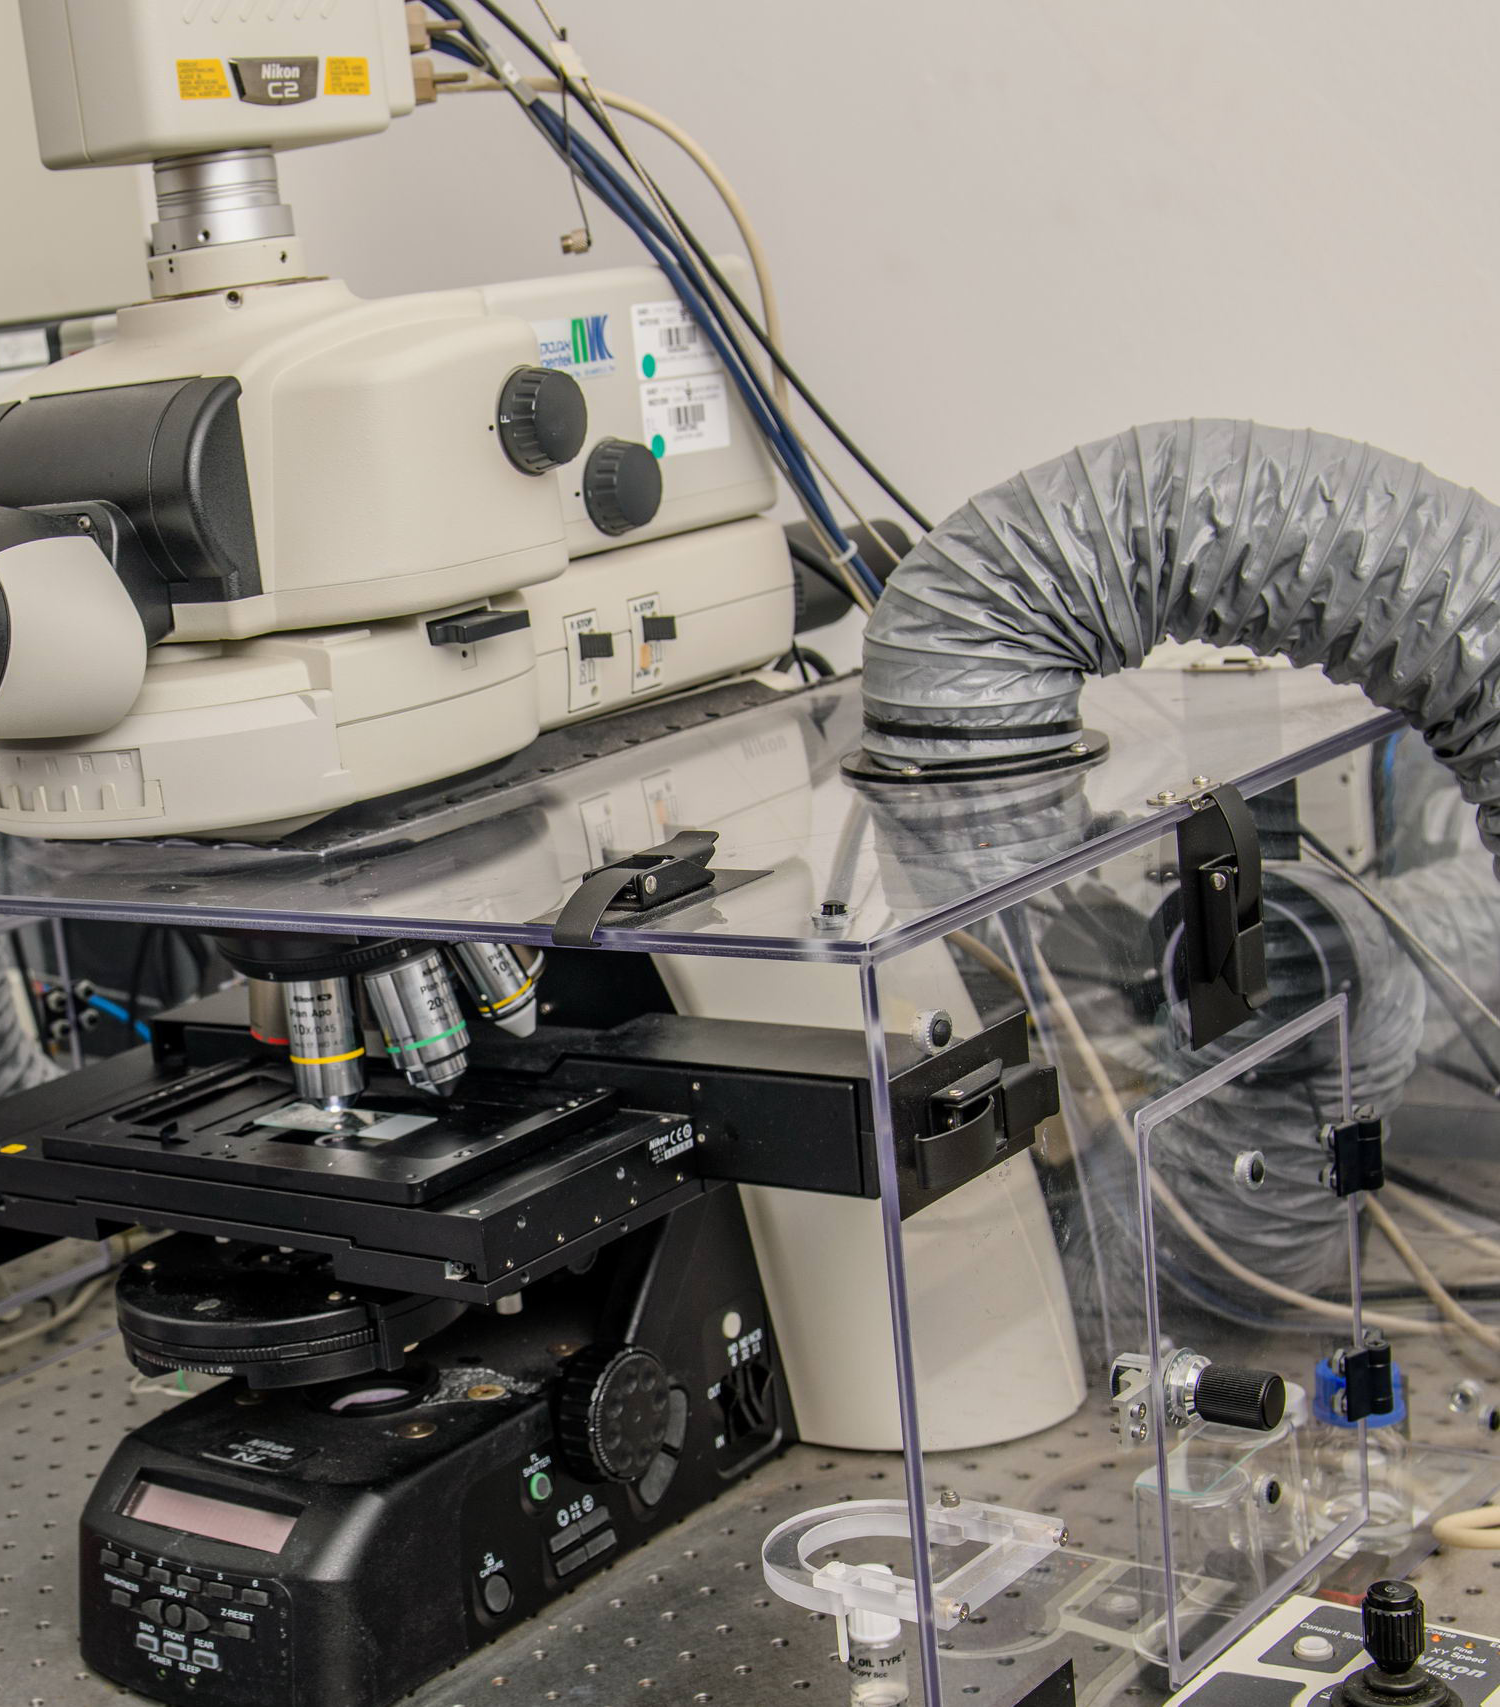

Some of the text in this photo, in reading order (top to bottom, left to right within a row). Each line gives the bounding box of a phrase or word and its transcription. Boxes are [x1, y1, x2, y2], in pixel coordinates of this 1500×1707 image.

[261, 64, 300, 80] Nikon
[268, 81, 300, 98] C2
[649, 1134, 669, 1151] Nikon
[522, 1455, 552, 1478] SHUTTER
[131, 1551, 136, 1560] 2
[185, 1566, 192, 1574] 4
[217, 1573, 224, 1581] 5
[252, 1579, 259, 1588] 6
[479, 1559, 505, 1578] CAPTURE
[103, 1572, 140, 1593] BRIGHTNESS
[160, 1585, 188, 1599] DISPLAY
[220, 1607, 255, 1622] Z-RESET
[1299, 1621, 1341, 1637] Constant
[1425, 1628, 1457, 1639] Coarse
[163, 1629, 186, 1642] FRONT
[194, 1637, 215, 1649] REAR
[1430, 1647, 1487, 1665] XY Speed
[1453, 1645, 1475, 1655] Fine
[148, 1652, 201, 1674] POWER SLEEP
[858, 1658, 875, 1668] OIL
[879, 1653, 902, 1667] TYPE
[1417, 1655, 1488, 1678] Nikon
